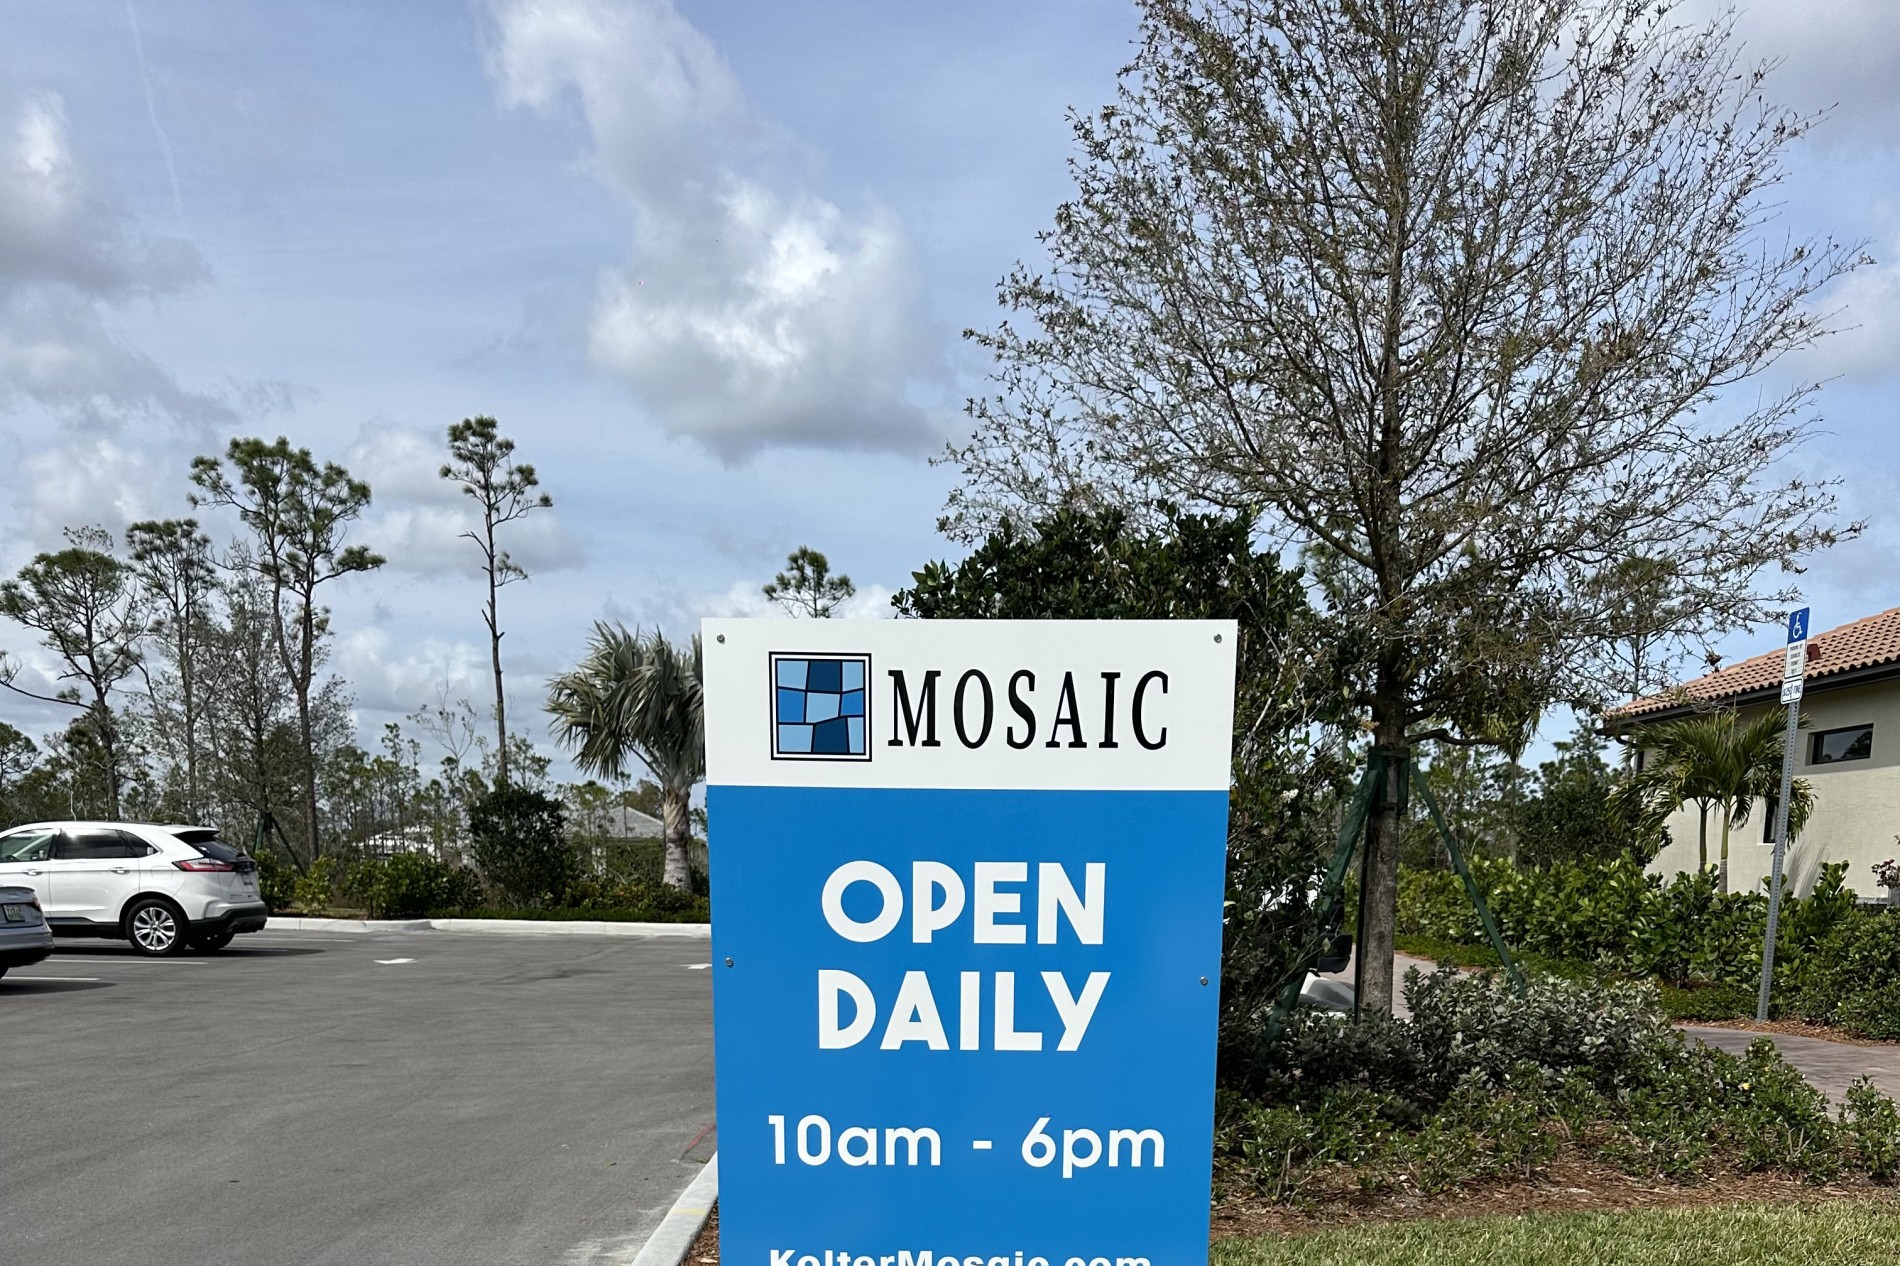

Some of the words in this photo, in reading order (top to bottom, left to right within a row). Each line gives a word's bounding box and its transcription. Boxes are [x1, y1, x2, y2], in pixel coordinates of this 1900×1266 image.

[887, 668, 1169, 751] MOSAIC
[821, 860, 1106, 945] OPEN
[818, 969, 1112, 1052] DAILY
[768, 1114, 941, 1167] 10am
[972, 1140, 993, 1150] -
[1021, 1117, 1165, 1179] 6pm
